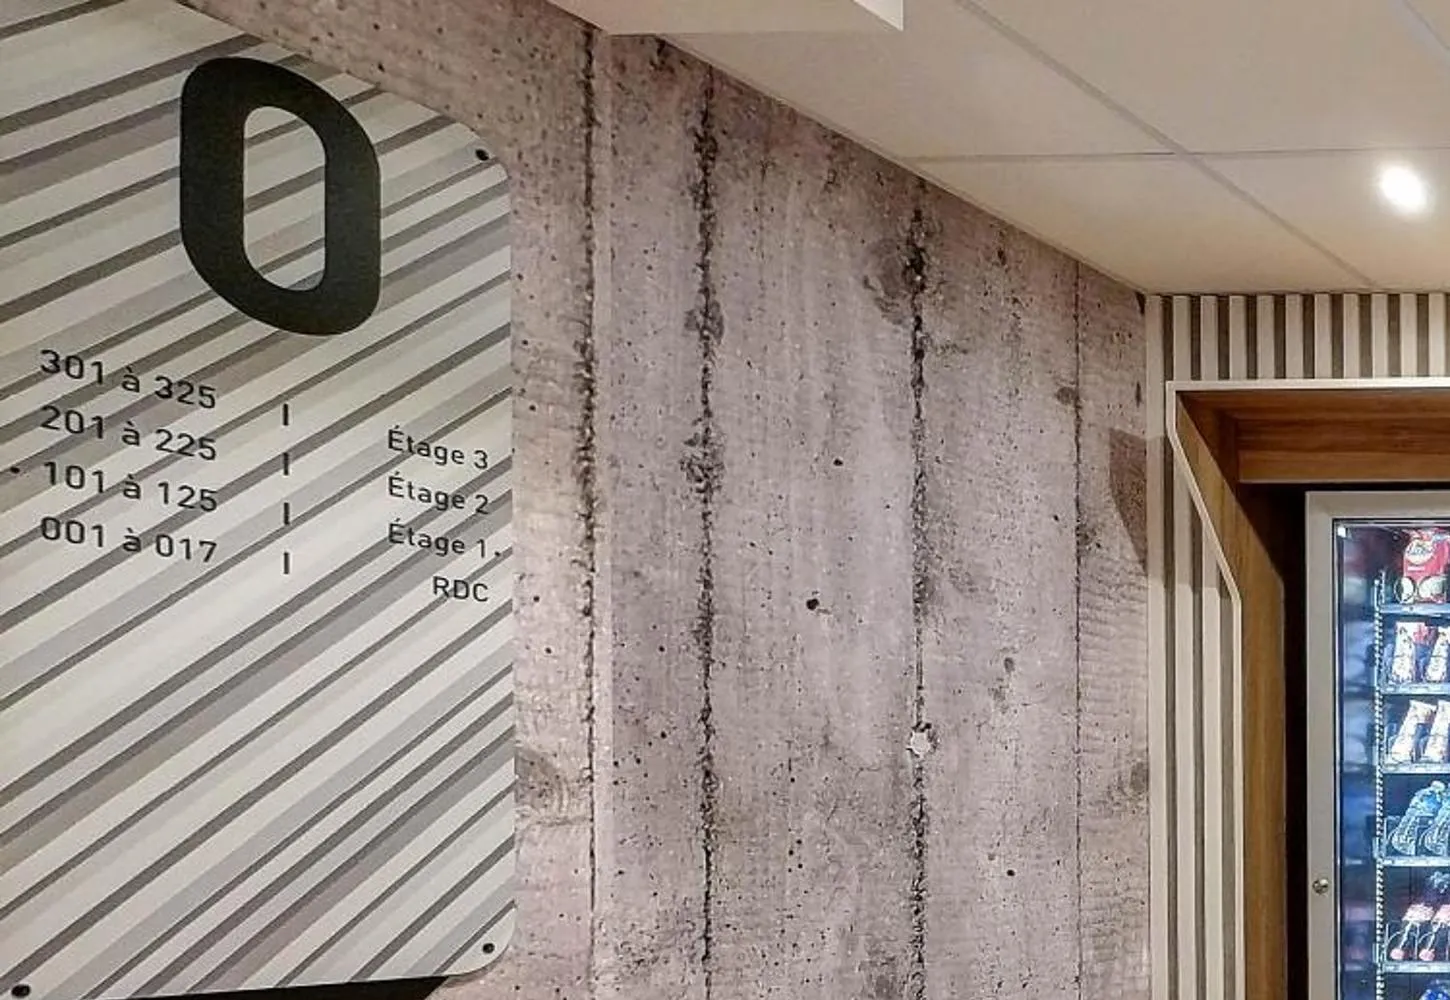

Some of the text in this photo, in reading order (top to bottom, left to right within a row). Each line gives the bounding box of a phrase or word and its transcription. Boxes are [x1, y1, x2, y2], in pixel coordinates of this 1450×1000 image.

[40, 349, 488, 470] 301 à 325 Étage 3
[40, 405, 489, 515] 201 à 225 Étage 2
[40, 516, 489, 602] 001 à 017 RDC
[43, 461, 486, 558] 101 à 125 Étage 1
